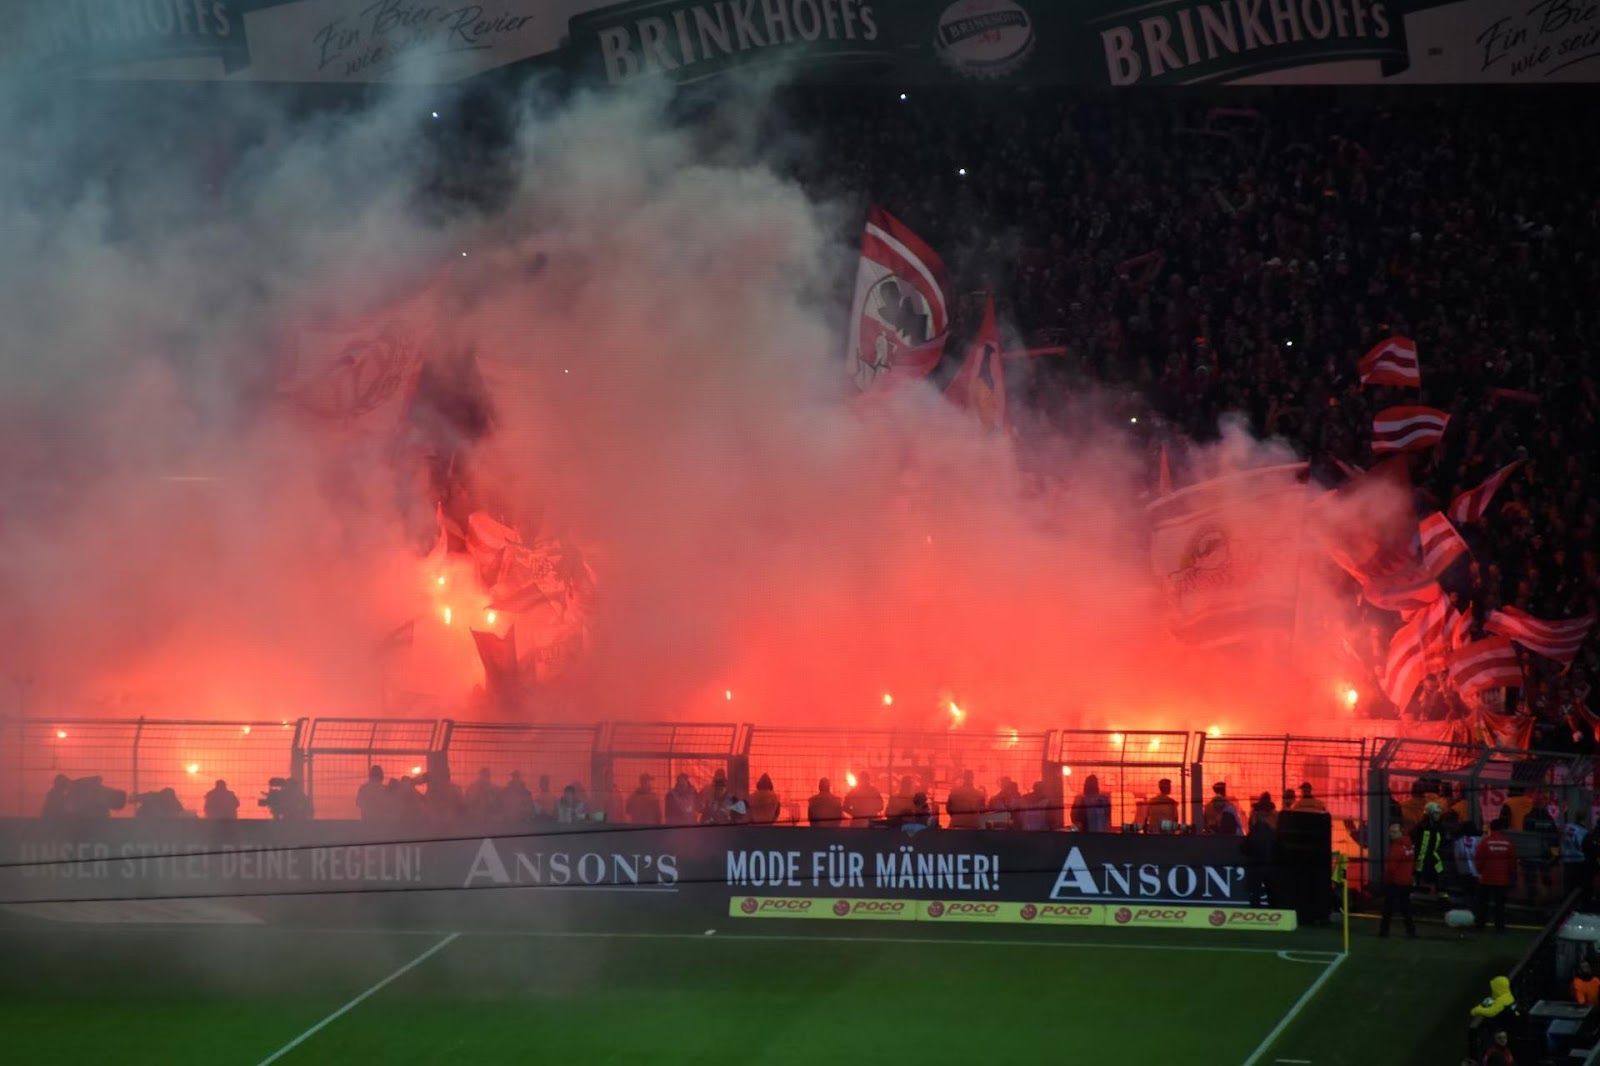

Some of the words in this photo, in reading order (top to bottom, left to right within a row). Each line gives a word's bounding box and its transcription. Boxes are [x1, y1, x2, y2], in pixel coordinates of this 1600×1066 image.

[437, 5, 536, 44] Revier
[1475, 16, 1527, 73] Ein
[1526, 0, 1600, 35] Bie
[1510, 45, 1551, 77] wie
[221, 843, 301, 880] DEINE
[310, 845, 422, 882] REGELN!
[463, 838, 680, 888] ANSON'S
[727, 850, 801, 887] MODE
[812, 845, 865, 888] FÜR
[875, 845, 1000, 891] MÄNNER!
[1049, 846, 1247, 898] ANSON'
[759, 899, 811, 909] POCO
[852, 901, 904, 911] POCO
[946, 903, 999, 913] POCO
[1040, 906, 1092, 916] POCO
[1134, 909, 1186, 919] POCO
[1228, 911, 1281, 921] POCO
